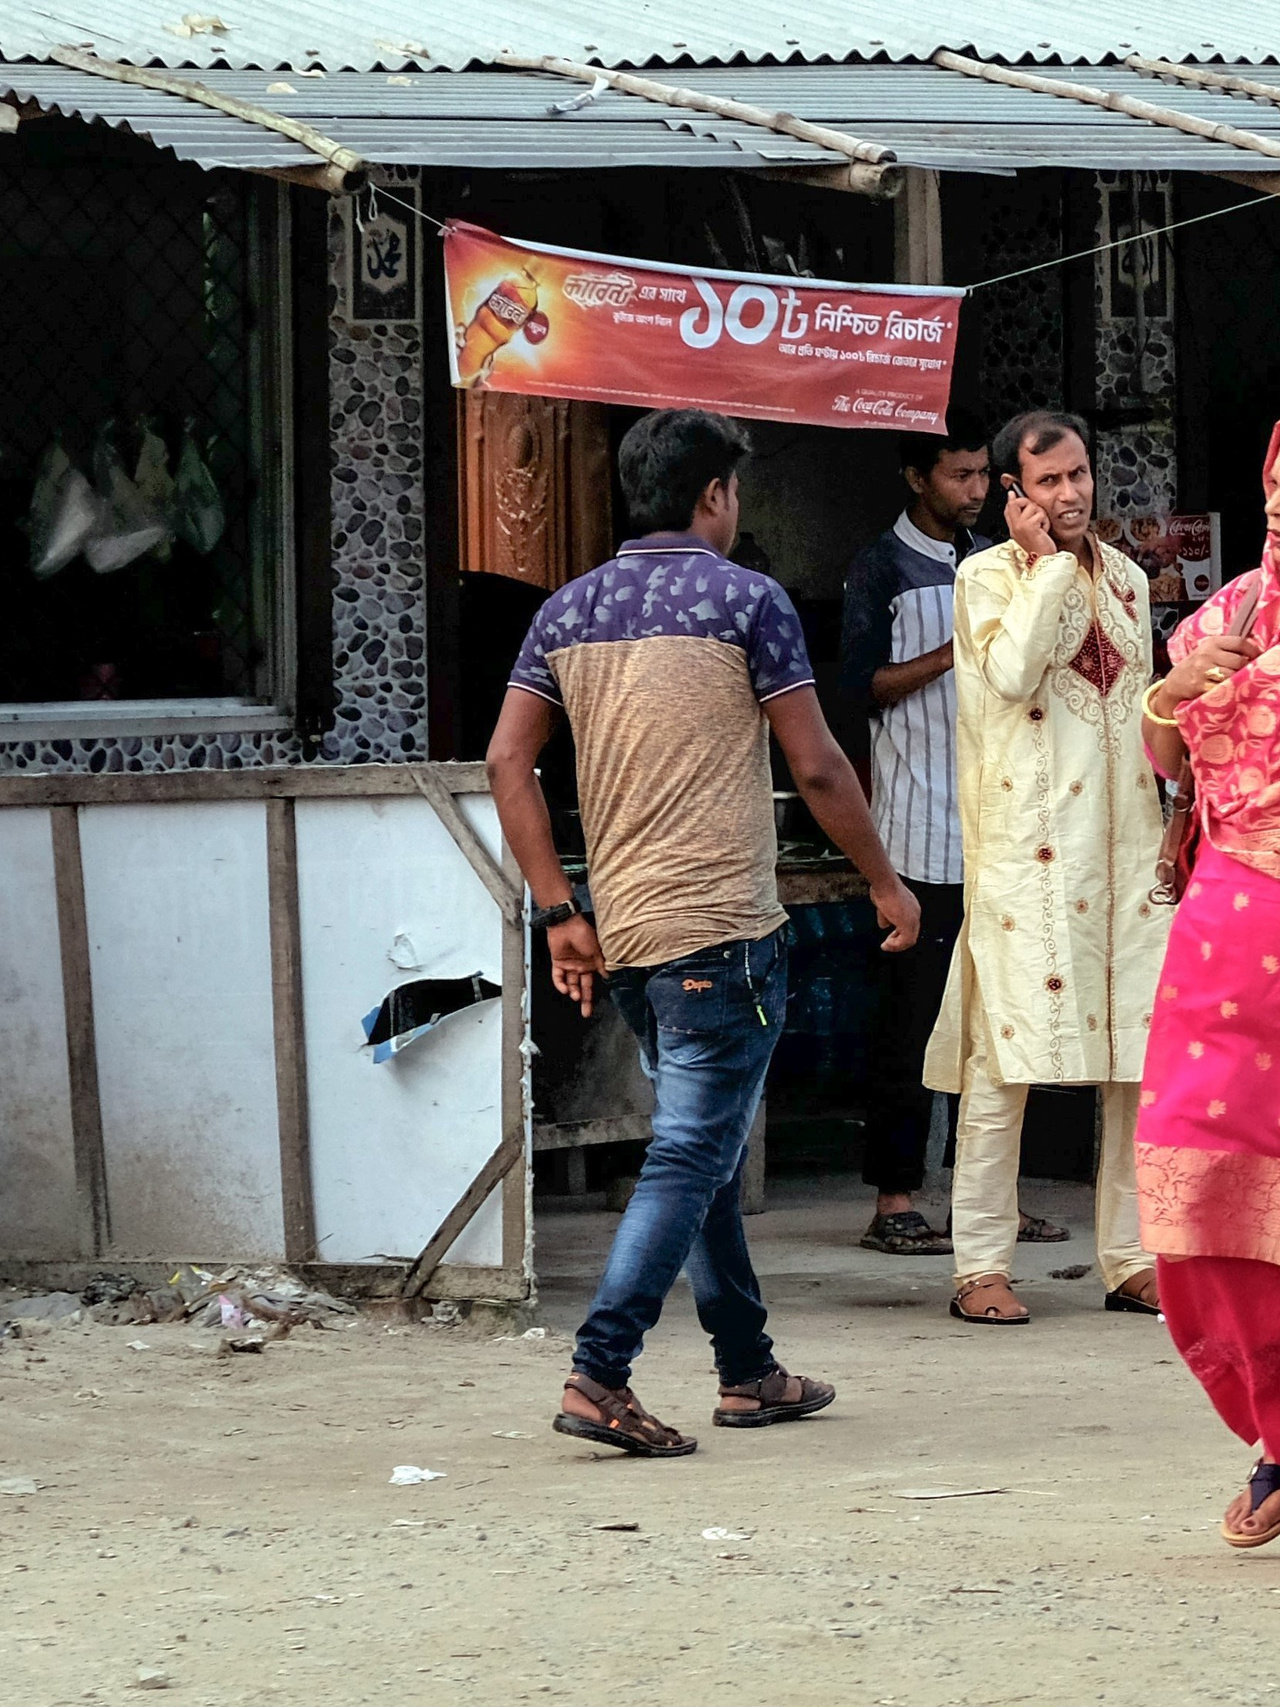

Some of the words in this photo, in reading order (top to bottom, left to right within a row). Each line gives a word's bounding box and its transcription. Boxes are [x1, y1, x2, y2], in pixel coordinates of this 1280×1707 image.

[815, 303, 882, 335] নিশ্চিত
[832, 395, 851, 412] The
[895, 402, 939, 425] Company
